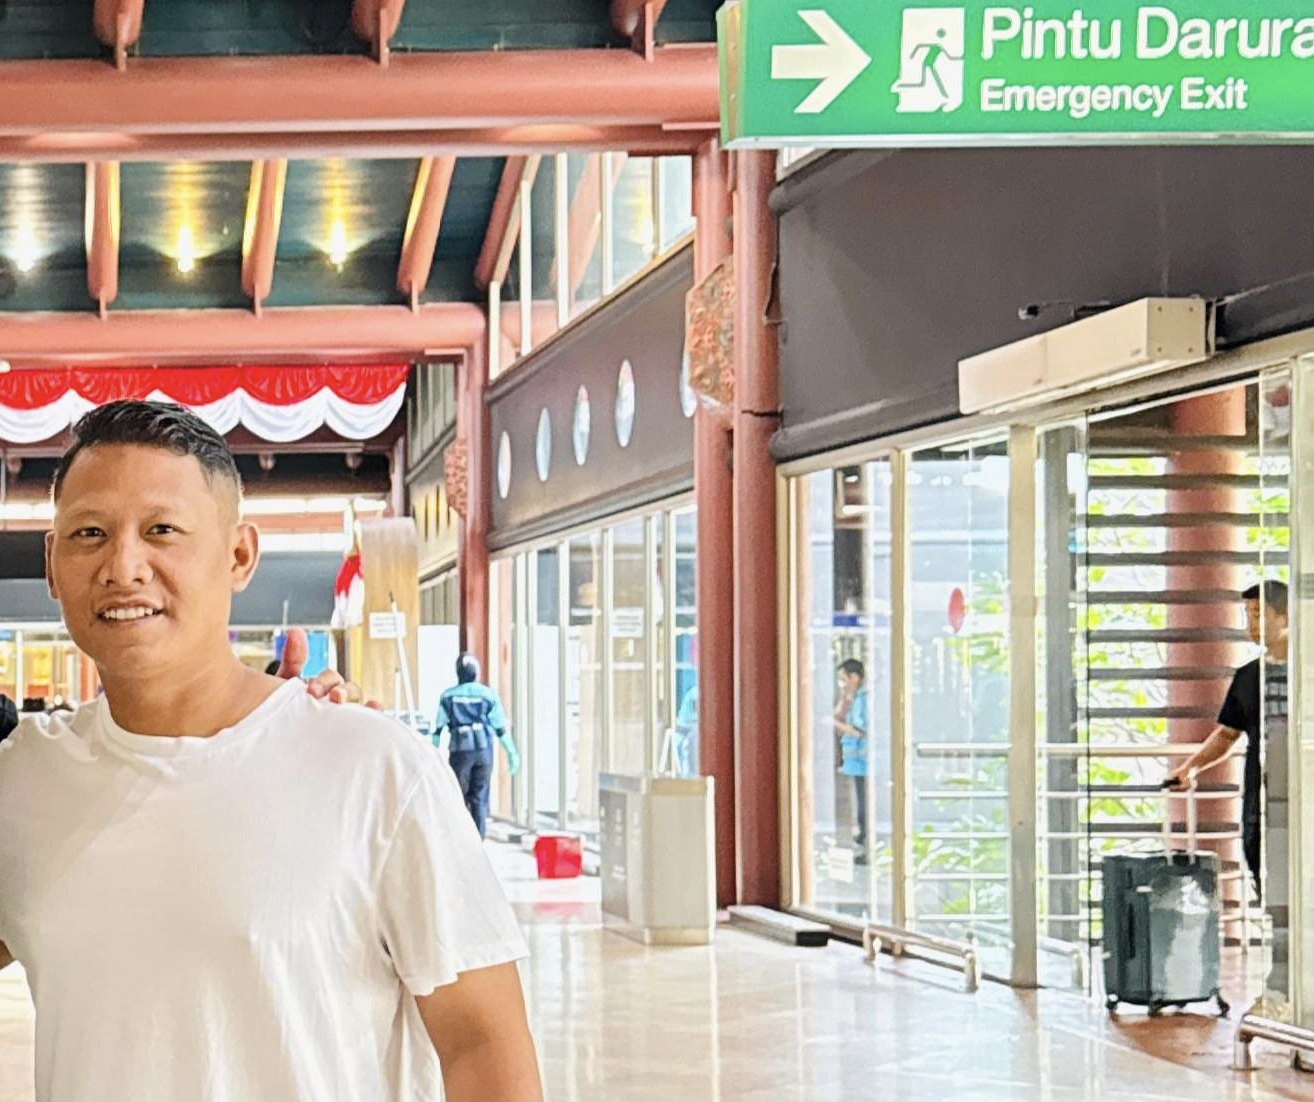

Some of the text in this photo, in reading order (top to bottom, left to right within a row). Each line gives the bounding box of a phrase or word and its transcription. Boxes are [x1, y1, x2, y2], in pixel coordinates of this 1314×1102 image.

[981, 5, 1314, 60] Pintu Darura
[980, 76, 1248, 118] Emergency Exit
